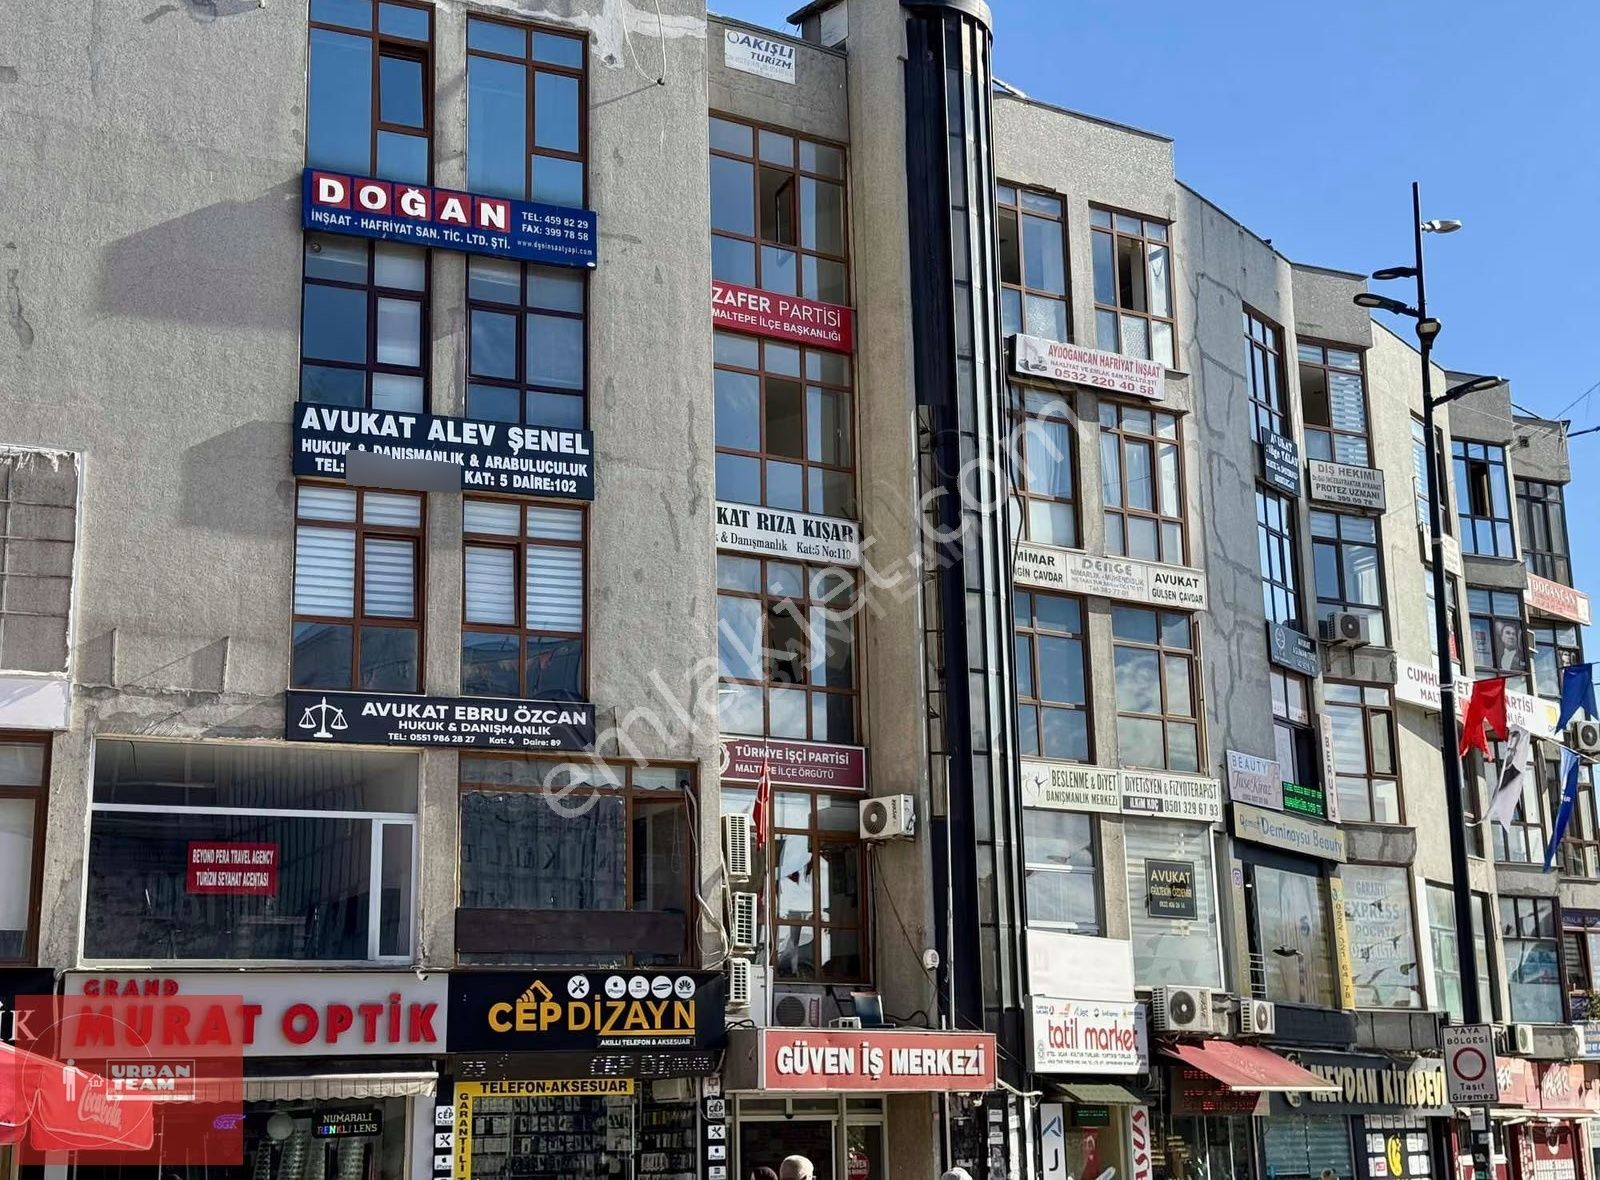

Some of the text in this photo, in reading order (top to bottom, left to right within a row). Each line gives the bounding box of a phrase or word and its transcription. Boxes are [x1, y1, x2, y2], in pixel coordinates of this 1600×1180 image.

[740, 36, 793, 59] AKIŞLI
[318, 178, 506, 229] DOĞAN
[311, 209, 353, 227] İNŞAAT
[360, 217, 413, 238] HAFRİYAT
[415, 226, 440, 241] SAN.
[442, 229, 464, 243] TİC.
[467, 233, 488, 247] LTD.
[491, 235, 511, 251] ŞTİ.
[522, 212, 588, 229] TEL: 459 82 29
[522, 224, 588, 241] FAX: 399 78 58
[712, 287, 840, 328] ZAFER PARTİSİ
[712, 308, 840, 341] MALTEPE İLÇE BAŞKANLIĞI
[1100, 354, 1134, 373] HAFRİYAT
[1135, 360, 1160, 378] İNŞAAT
[1054, 368, 1154, 395] 0532 220 40 58
[301, 407, 590, 455] AVUKAT ALEV ŞENEL
[302, 439, 351, 455] HUKUK
[470, 455, 479, 467] &
[485, 456, 588, 477] ARABULUCULUK
[315, 458, 344, 472] TEL:
[464, 471, 494, 486] KAT:
[500, 473, 508, 487] 5
[1316, 483, 1380, 499] PROTEZ UZMANI
[757, 512, 796, 535] RIZA
[803, 519, 853, 543] KIŞAR
[721, 531, 728, 543] &
[731, 533, 788, 551] Danışmanlık
[797, 542, 819, 554] Kat:5
[1033, 570, 1063, 582] ÇAVDAR
[1152, 587, 1176, 601] GÜLŞEN
[1179, 592, 1203, 604] ÇAVDAR
[1155, 573, 1199, 588] AVUKAT
[361, 702, 587, 725] AVUKAT EBRU ÖZCAN
[388, 732, 407, 741] TEL:
[410, 734, 431, 742] 0551
[433, 735, 450, 743] 986
[451, 735, 463, 743] 28
[508, 737, 514, 745] 4
[522, 737, 549, 746] Daire:
[551, 738, 561, 746] 89
[398, 720, 551, 735] HUKUK & DANIŞMANLIK
[735, 744, 849, 765] TÜRKİYE İŞÇİ PARTİSİ
[1232, 755, 1266, 774] BEAUTY
[778, 767, 798, 779] İLÇE
[798, 767, 834, 779] ÖRGÜTÜ
[1052, 770, 1089, 789] BESLENME
[1091, 777, 1095, 789] &
[1164, 783, 1168, 794] &
[1046, 791, 1089, 804] DANIŞMANLIK
[1165, 800, 1180, 812] 0501
[1184, 801, 1196, 814] 329
[1199, 804, 1206, 815] 67
[1210, 804, 1218, 816] 93
[193, 849, 273, 864] BEYOND PERA TRAVEL AGENCY
[218, 872, 242, 886] SEYAHAT
[1151, 870, 1190, 884] AVUKAT
[83, 979, 179, 997] GRAND
[74, 993, 439, 1047] MURAT OPTİK
[488, 995, 696, 1035] CEP DİZAYN
[658, 1038, 691, 1046] AKSESUAR
[1048, 1017, 1139, 1051] tatil market
[1447, 1036, 1488, 1045] BÖLGESİ
[1453, 1027, 1480, 1035] YAYA
[776, 1041, 985, 1079] GÜVEN İŞ MERKEZİ
[1452, 1092, 1495, 1101] Giremez
[323, 1113, 372, 1123] NUMARALI
[354, 1124, 377, 1132] LENS
